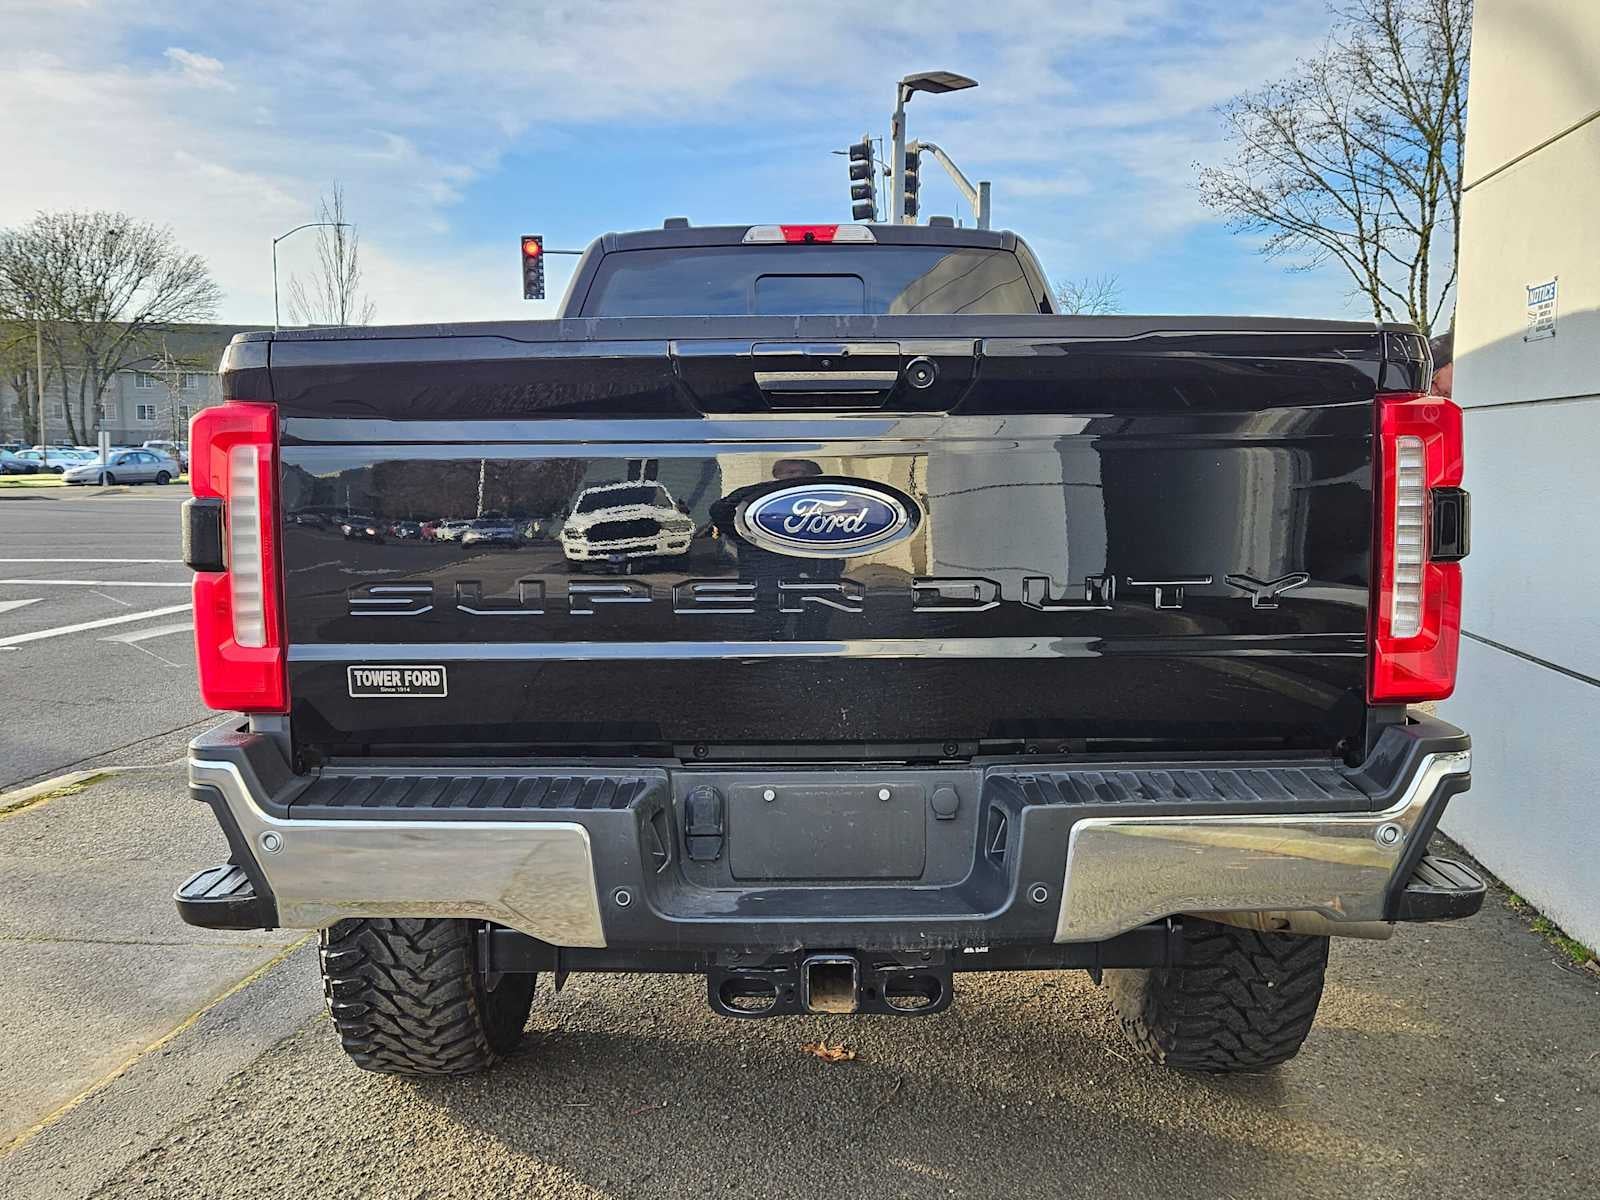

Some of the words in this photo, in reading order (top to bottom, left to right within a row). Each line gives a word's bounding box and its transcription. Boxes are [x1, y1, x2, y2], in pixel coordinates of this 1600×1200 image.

[1529, 284, 1554, 303] NOTICE
[783, 498, 869, 534] Ford
[348, 577, 866, 616] SUPER
[911, 572, 1310, 612] DUTY
[353, 670, 401, 686] TOWER
[404, 670, 440, 686] FORD
